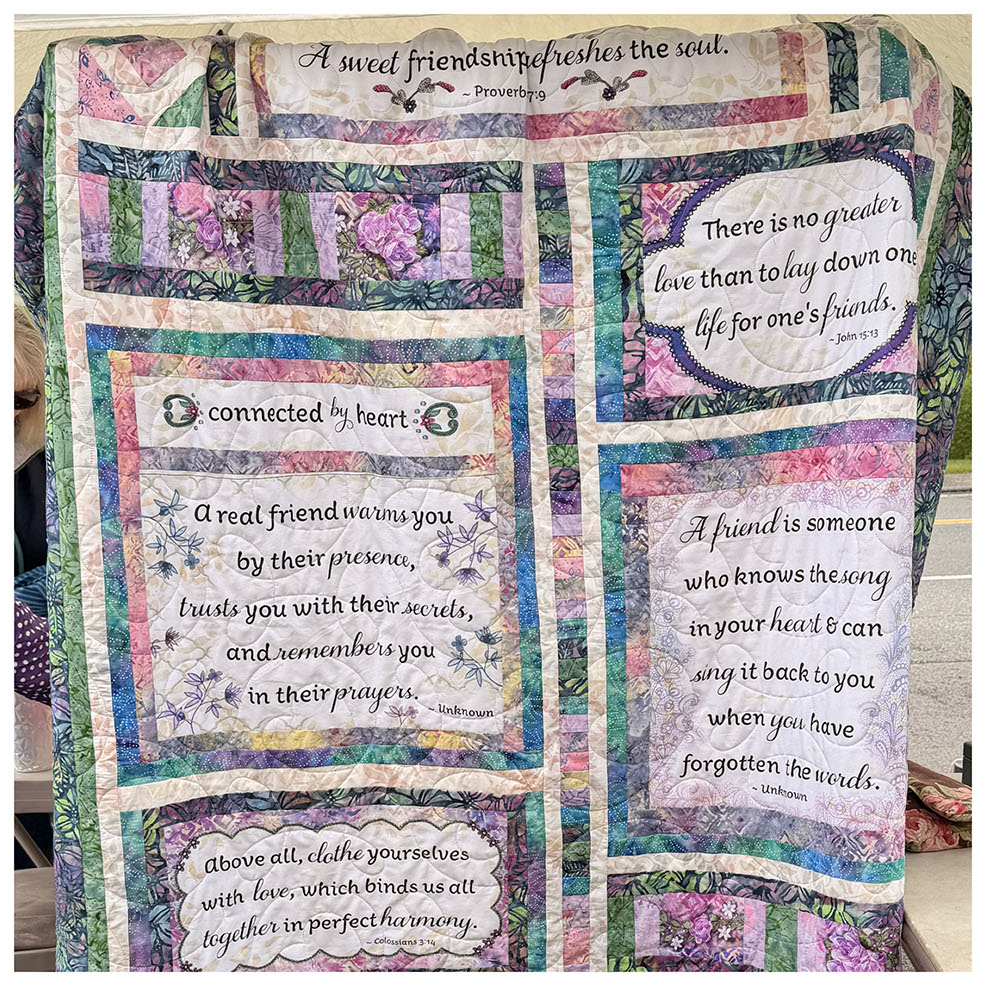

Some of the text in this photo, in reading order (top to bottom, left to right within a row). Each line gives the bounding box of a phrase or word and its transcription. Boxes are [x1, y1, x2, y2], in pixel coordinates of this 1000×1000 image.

[298, 42, 334, 69] A
[339, 50, 400, 75] sweet
[630, 39, 669, 60] the
[675, 34, 729, 58] soul.
[702, 192, 902, 243] There is no greater
[654, 264, 695, 293] love
[700, 267, 752, 288] than
[759, 264, 780, 282] to
[783, 250, 819, 294] lay
[823, 250, 880, 273] down
[695, 282, 896, 350] life for one's friends.
[836, 331, 858, 345] John
[859, 328, 879, 341] 15:13
[208, 396, 409, 433] connected by heart
[217, 504, 263, 526] real
[266, 500, 338, 532] friend
[343, 504, 410, 523] warms
[411, 507, 454, 534] you
[679, 506, 896, 553] A friend is someone
[237, 549, 416, 579] by their presence,
[684, 563, 893, 602] who knows the song
[179, 594, 474, 624] trusts you with their secrets,
[689, 606, 884, 640] in your heart & can
[226, 631, 436, 664] and remembers you
[690, 661, 875, 695] sing it back to you
[248, 682, 419, 713] in their prayers.
[437, 703, 494, 718] Unknown
[707, 707, 855, 742] when you have
[679, 753, 881, 791] forgotten the words.
[270, 847, 303, 866] all,
[307, 839, 364, 864] clothe
[366, 845, 470, 865] yourselves
[201, 877, 476, 912] with love, which binds us all
[202, 906, 478, 959] together in perfect harmony.
[374, 937, 418, 946] Colossians
[418, 938, 436, 947] 3:14
